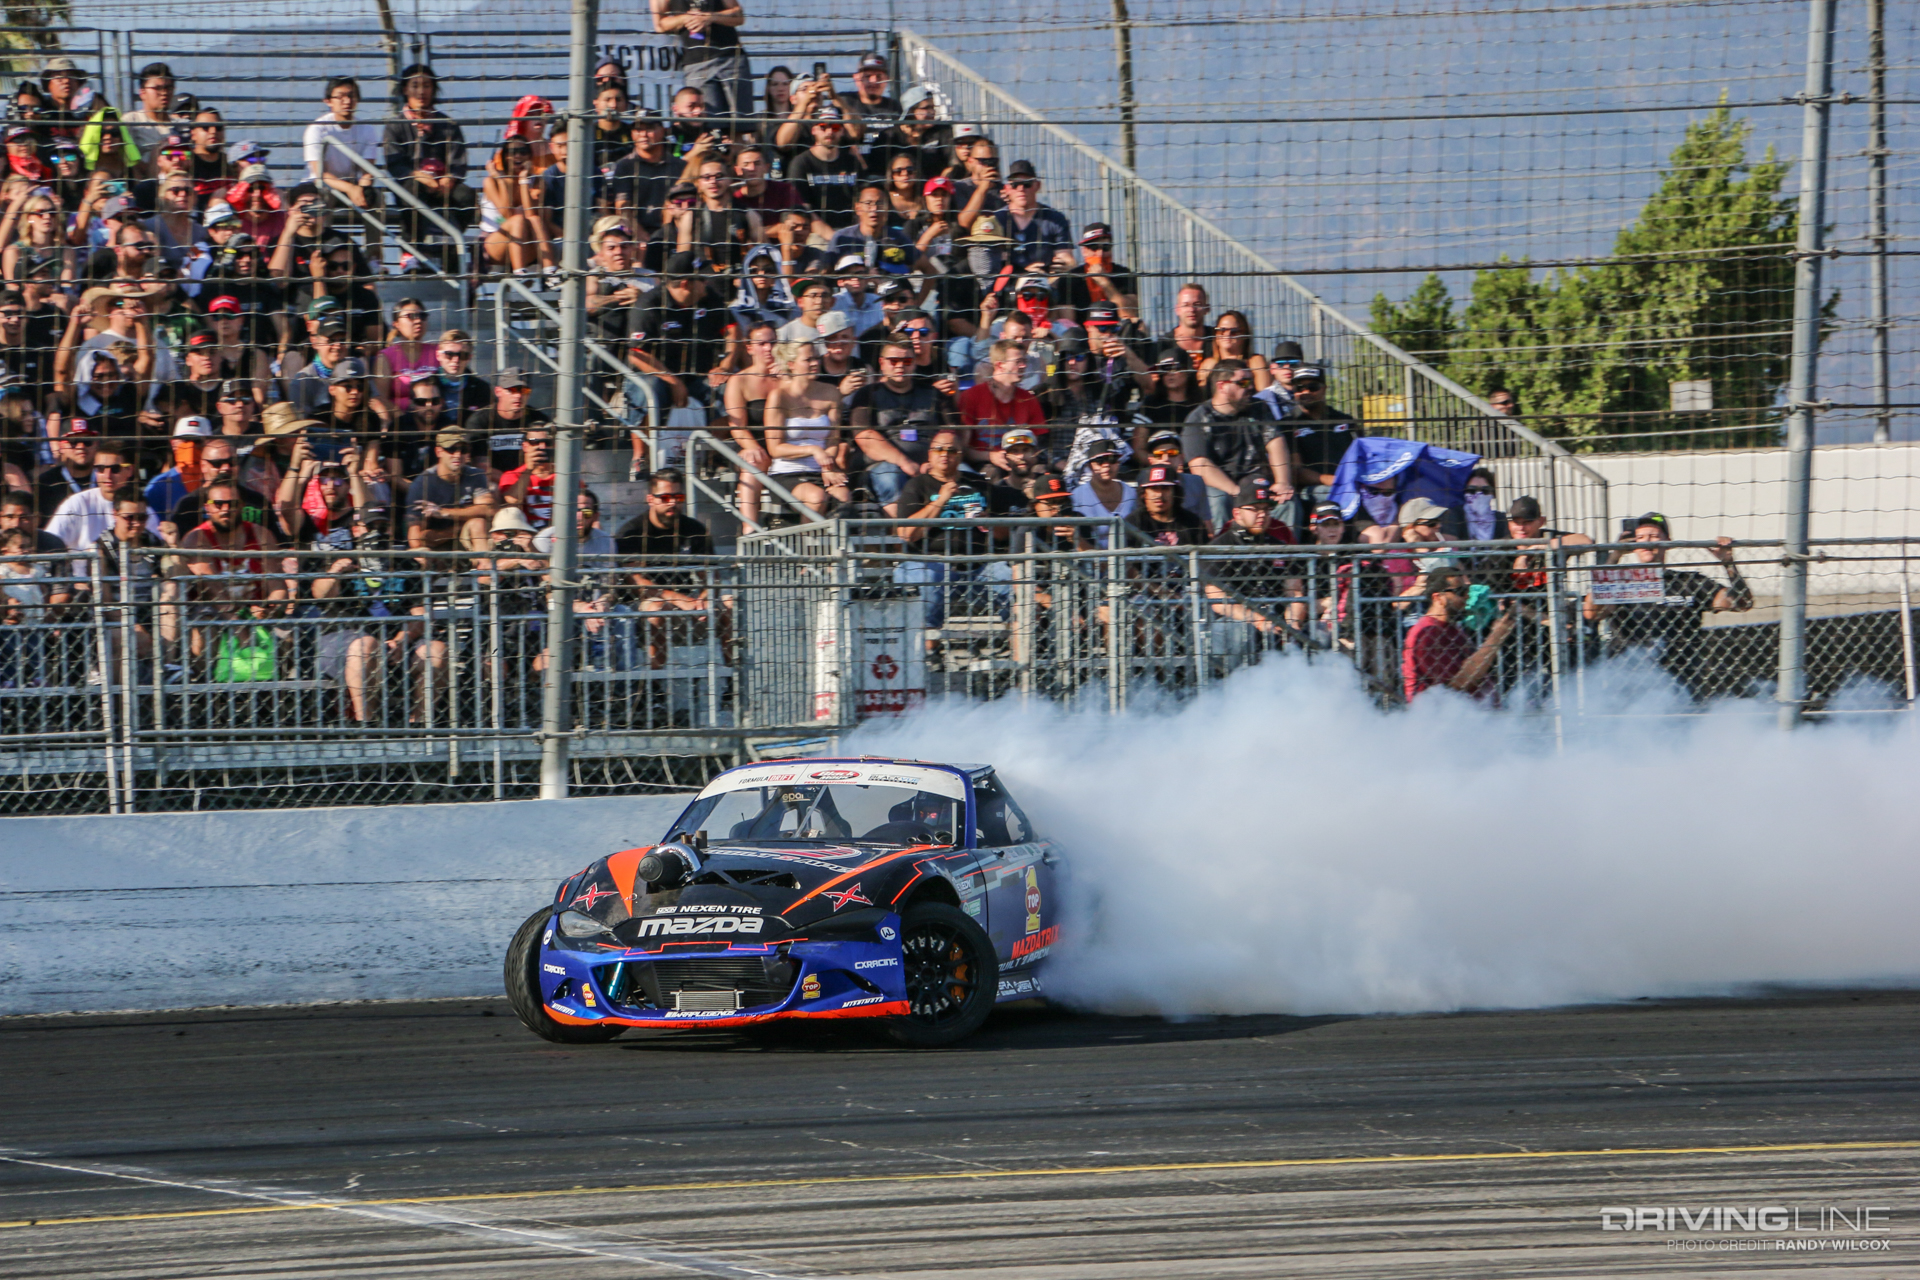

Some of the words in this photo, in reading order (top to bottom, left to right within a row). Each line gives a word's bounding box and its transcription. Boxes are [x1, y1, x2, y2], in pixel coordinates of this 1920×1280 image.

[739, 776, 769, 785] FORMULA
[769, 774, 796, 783] DRIFT
[1027, 893, 1040, 909] TOP
[680, 905, 726, 913] NEXEN
[730, 905, 763, 914] TIRE
[1011, 923, 1061, 960] MAZDATRIX
